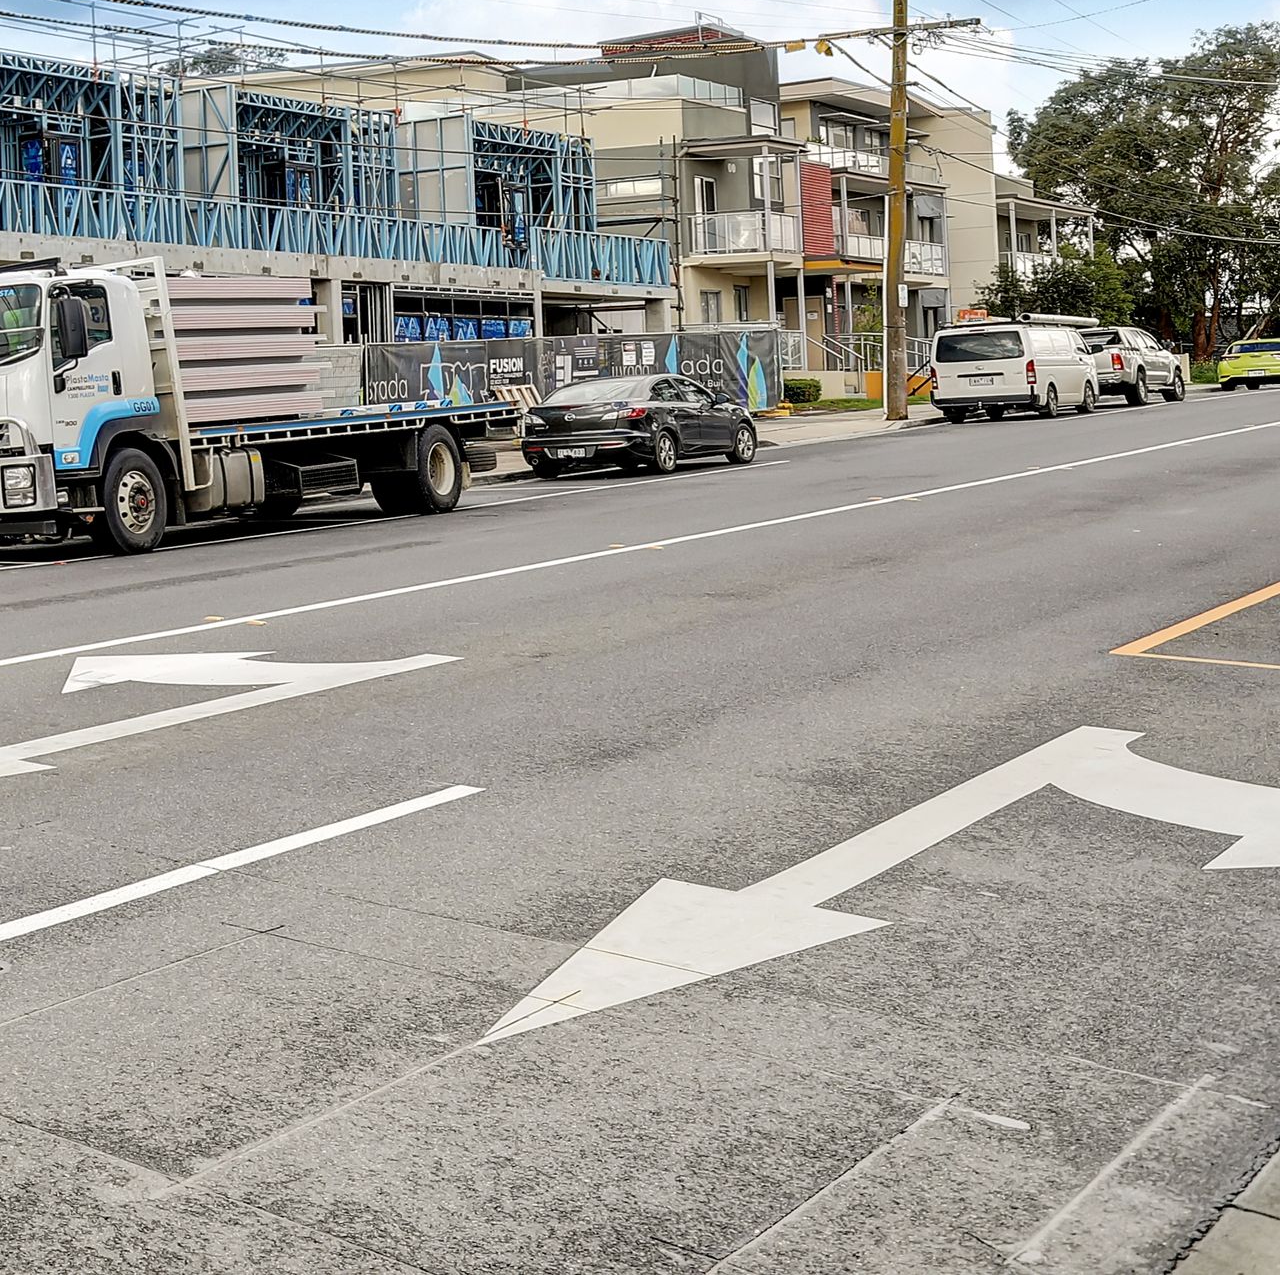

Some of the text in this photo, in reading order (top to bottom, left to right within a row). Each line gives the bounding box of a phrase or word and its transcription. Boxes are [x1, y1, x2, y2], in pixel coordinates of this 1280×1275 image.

[490, 357, 523, 373] FUSION
[66, 374, 109, 384] PlastaMasta
[133, 402, 155, 413] GG01
